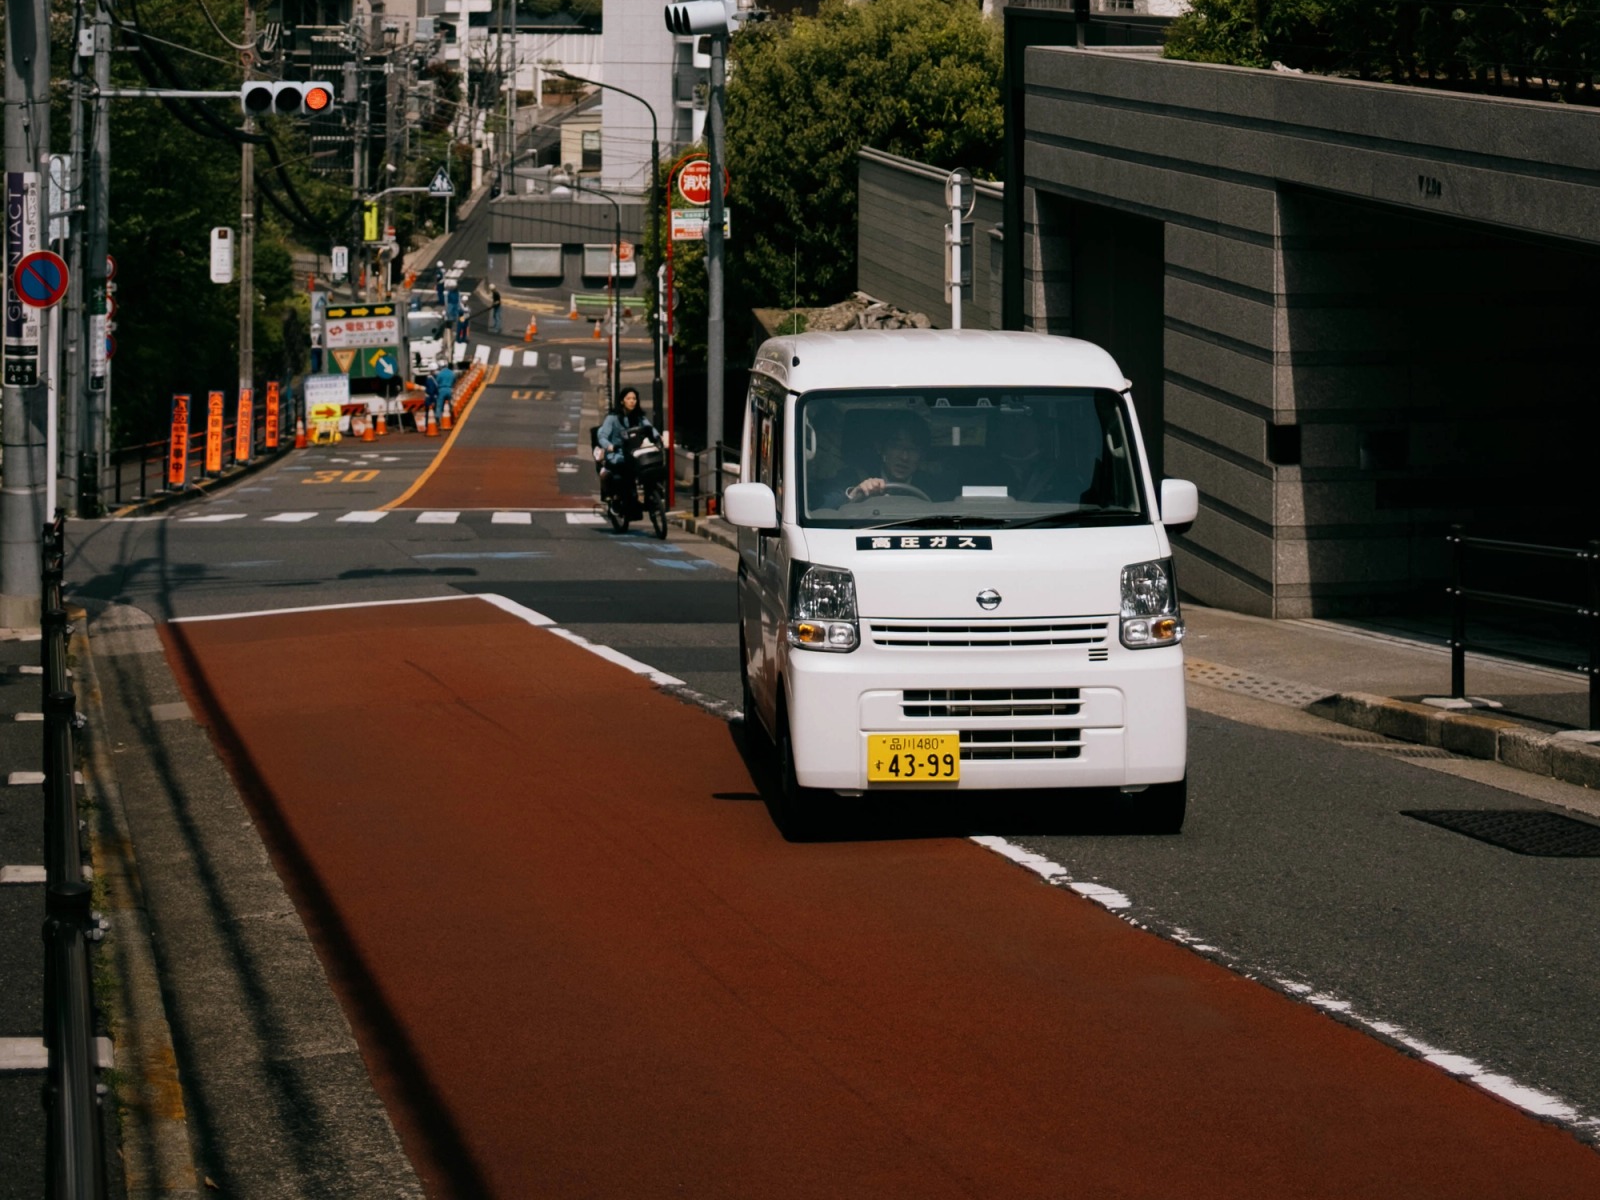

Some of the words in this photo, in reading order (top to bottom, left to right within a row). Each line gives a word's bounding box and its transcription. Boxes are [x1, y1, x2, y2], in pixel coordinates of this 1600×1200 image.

[301, 469, 381, 484] 30
[871, 537, 977, 549] 高圧ガス
[875, 760, 884, 771] す
[888, 754, 954, 777] 43-99
